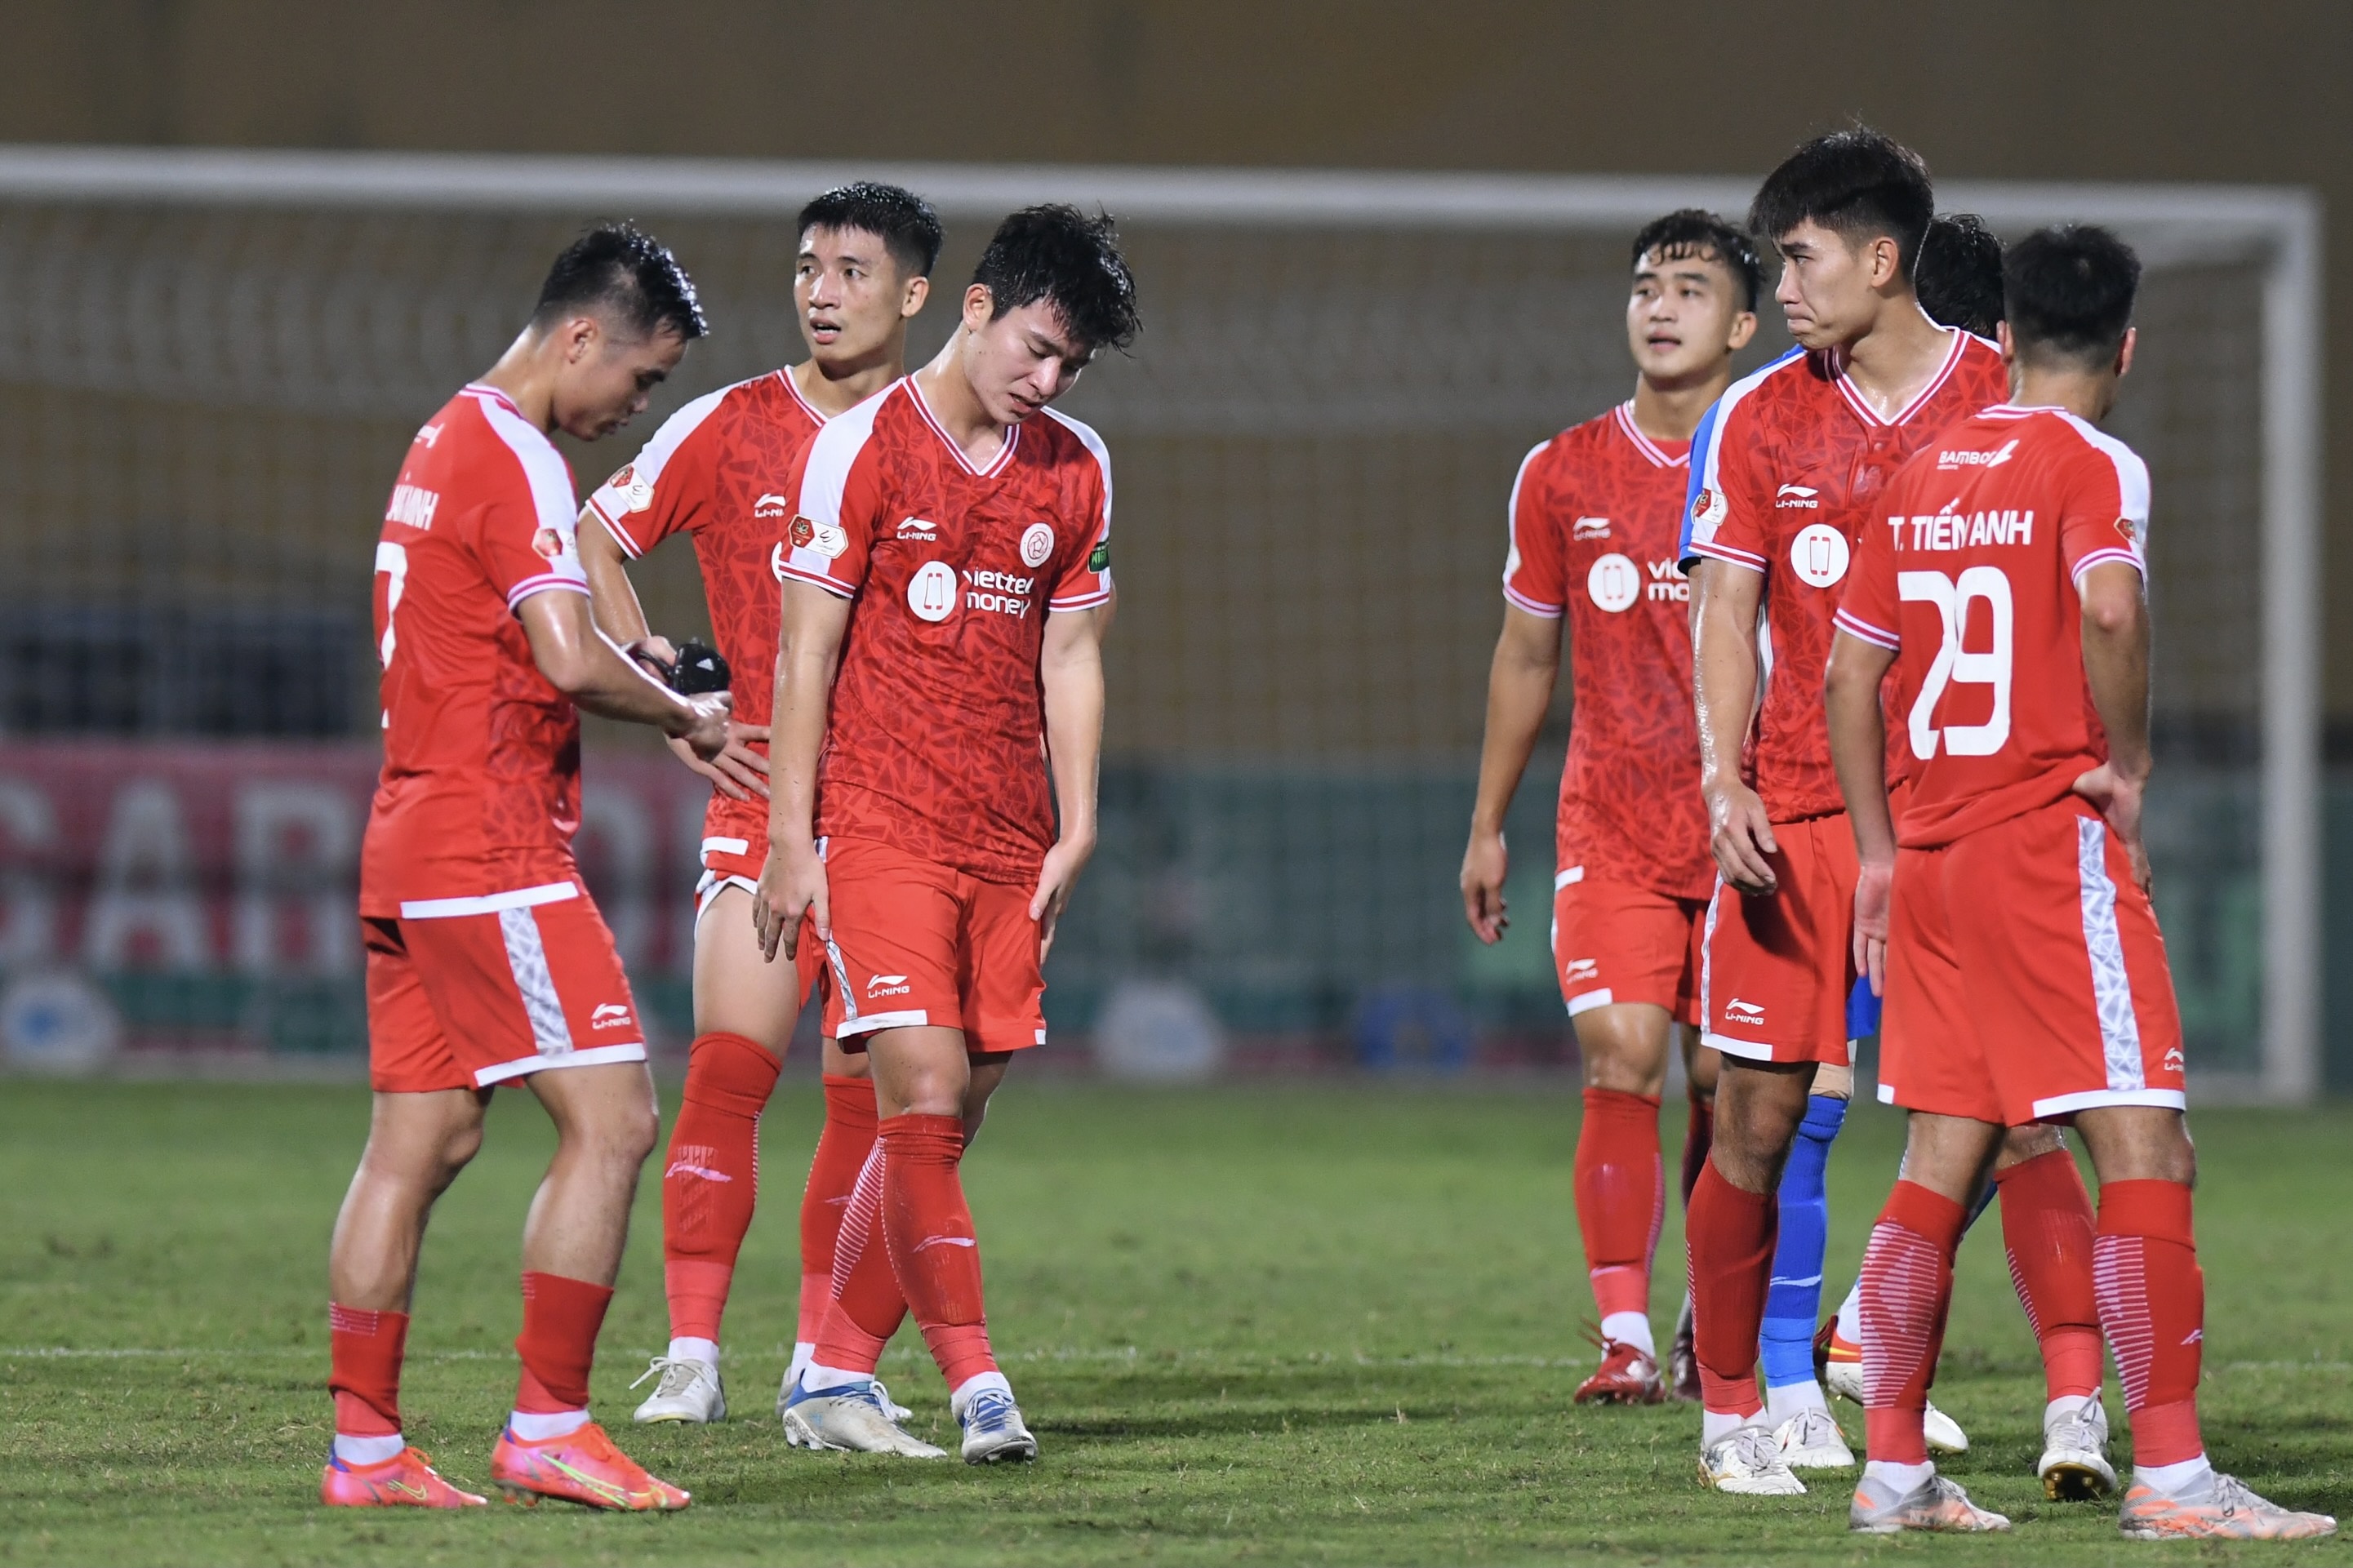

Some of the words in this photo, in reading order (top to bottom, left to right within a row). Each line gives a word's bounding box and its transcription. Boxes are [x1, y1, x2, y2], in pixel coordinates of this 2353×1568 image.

[1775, 500, 1818, 509] LI-NING
[754, 509, 785, 517] LI-NI
[1897, 566, 2013, 760] 29
[868, 985, 910, 999] LI-NING
[1724, 1011, 1764, 1025] LI-NING
